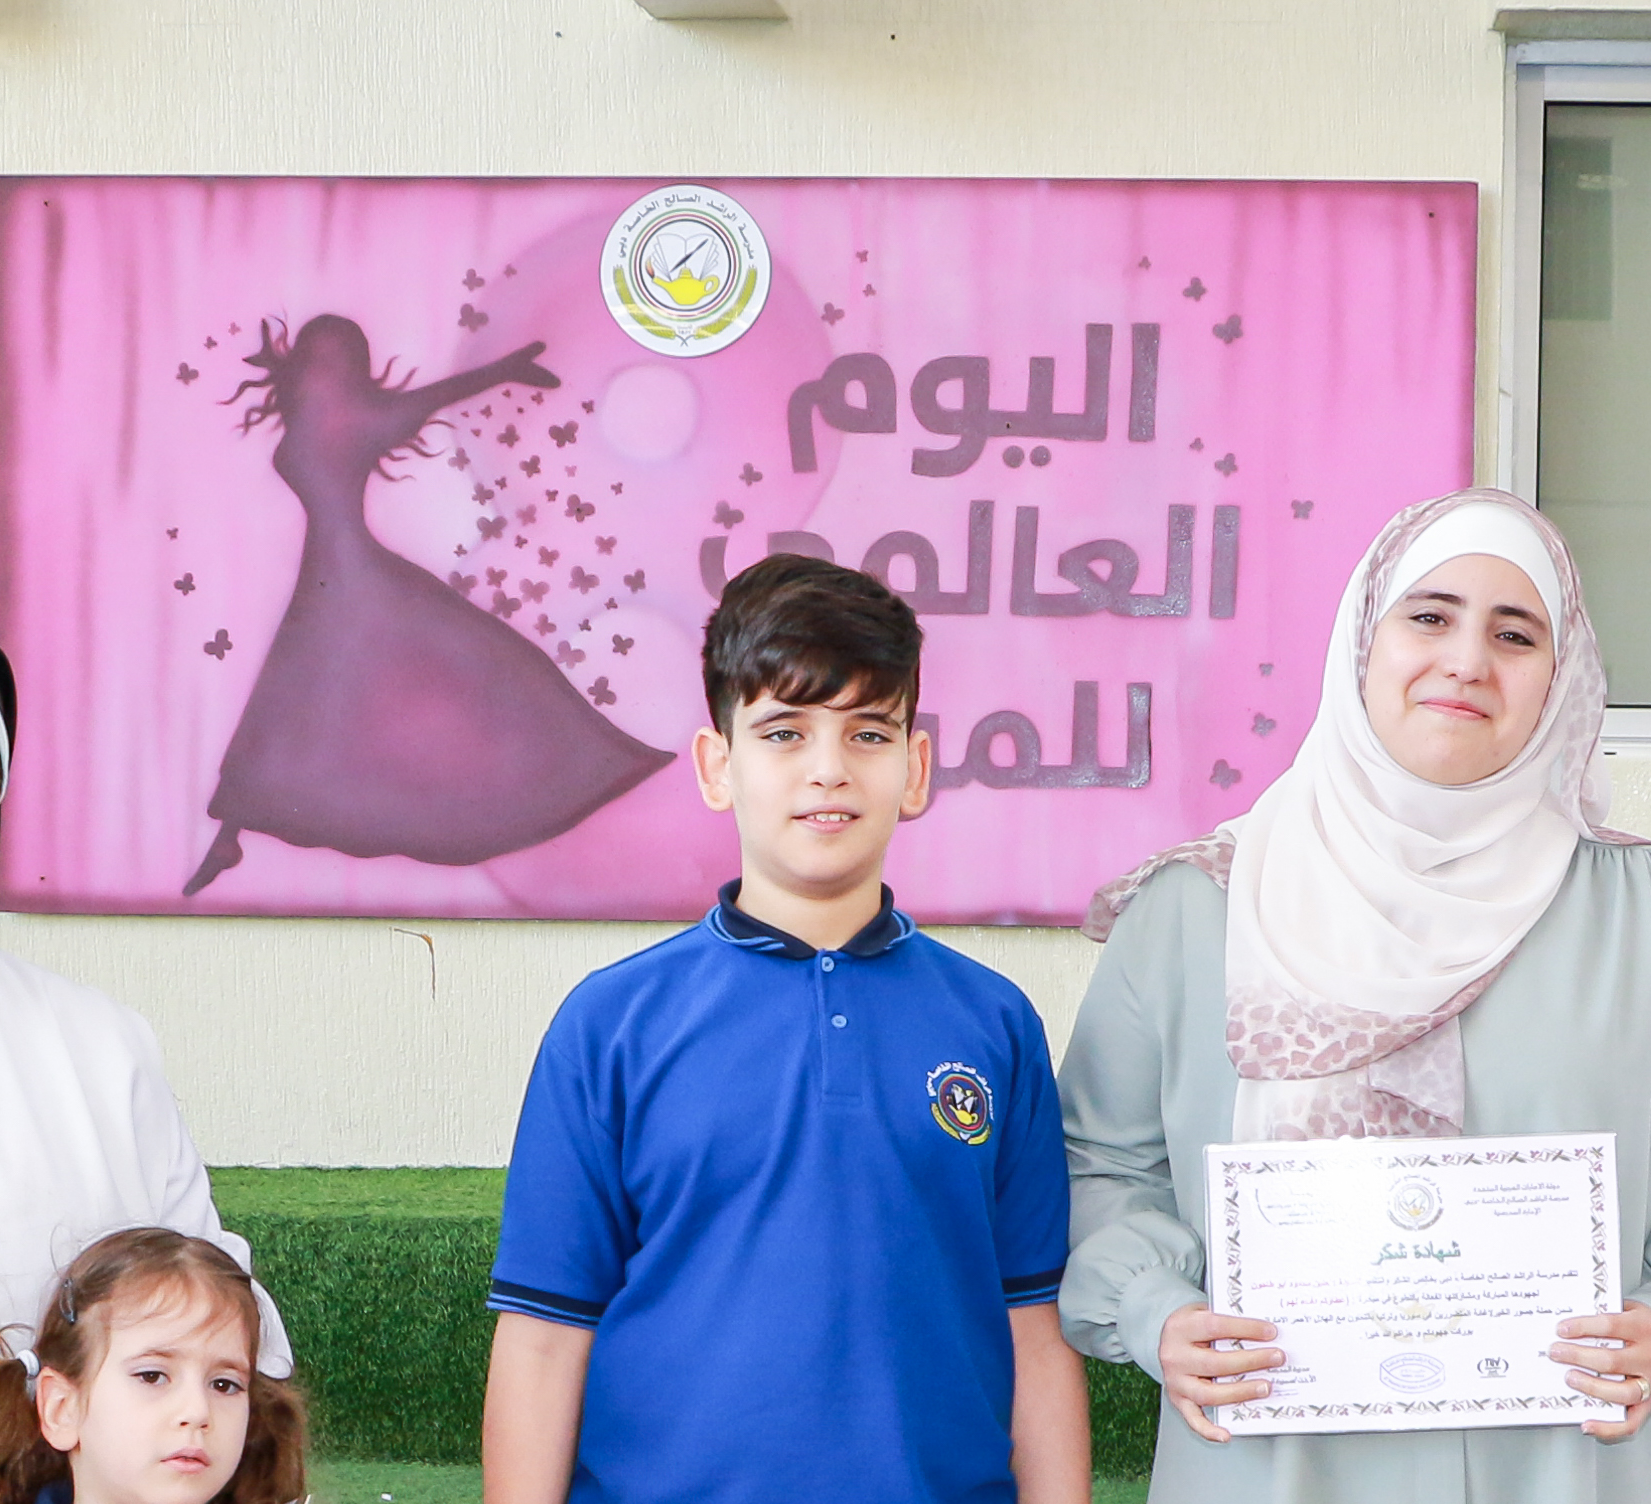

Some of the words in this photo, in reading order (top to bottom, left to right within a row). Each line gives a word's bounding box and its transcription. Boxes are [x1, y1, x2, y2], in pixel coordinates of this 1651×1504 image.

[664, 194, 701, 208] الصالح
[786, 323, 1160, 477] اليوم
[1370, 1242, 1407, 1266] شكر
[1413, 1240, 1461, 1263] شهادة
